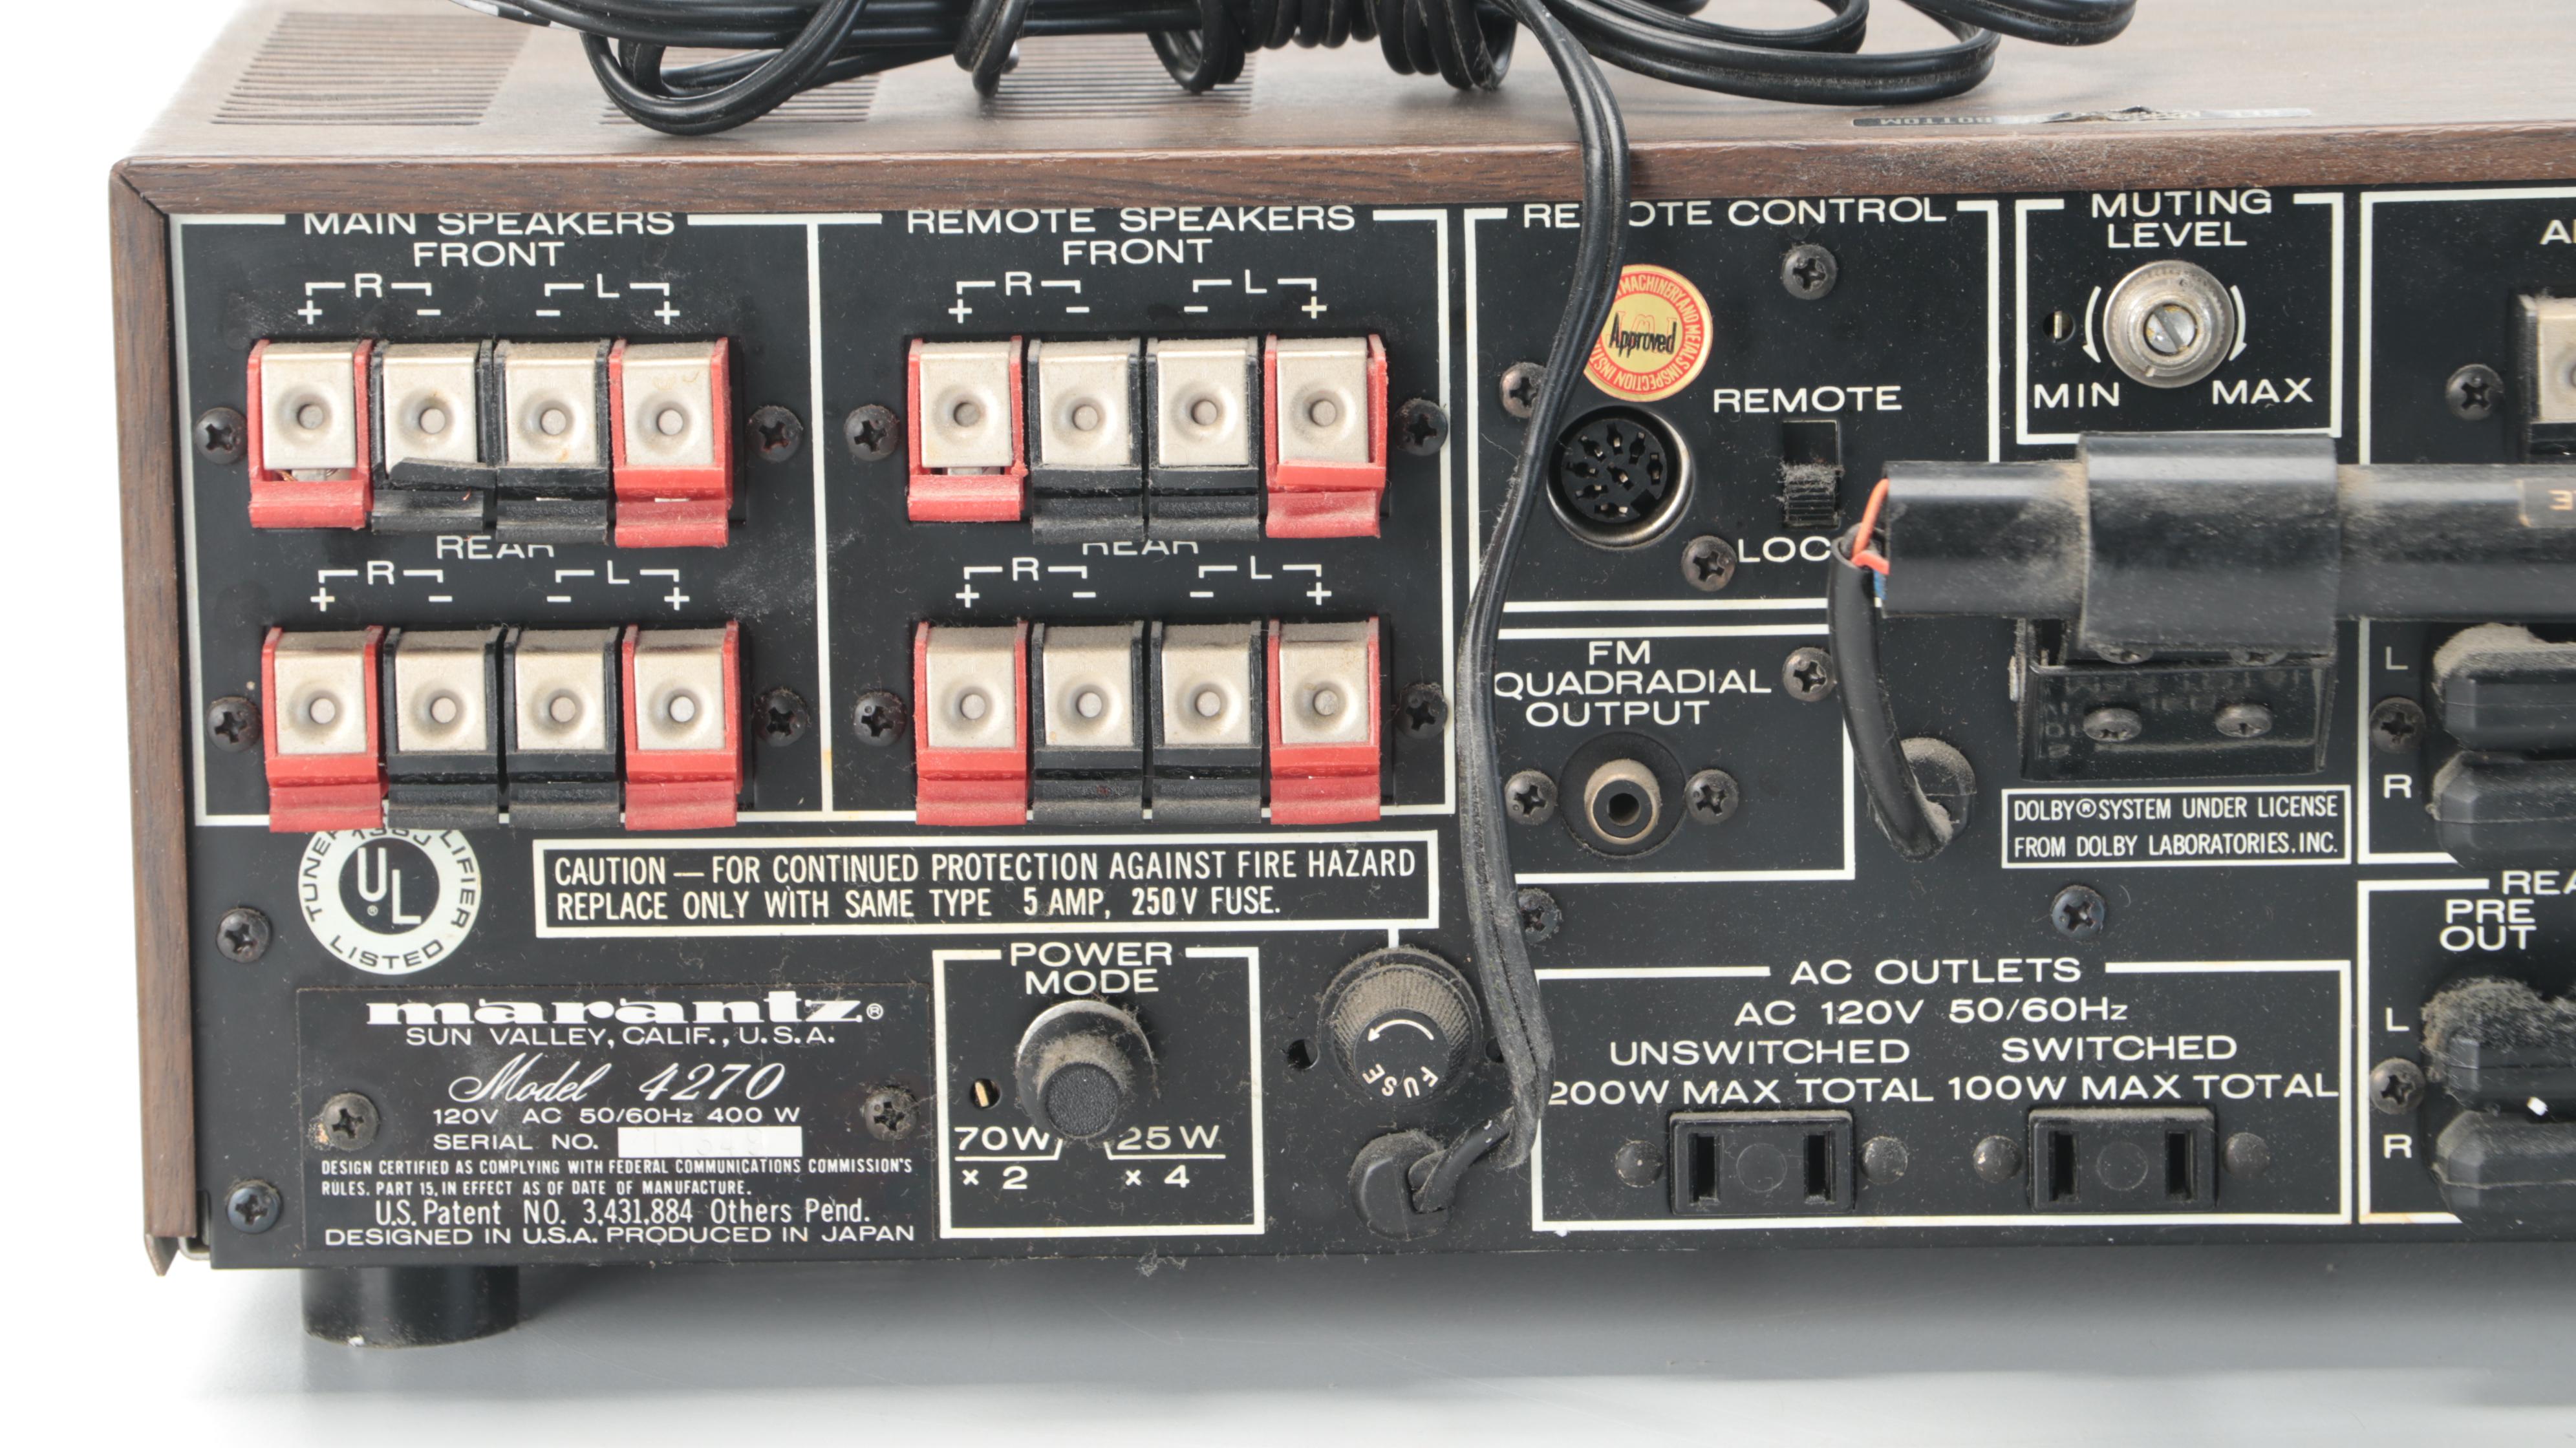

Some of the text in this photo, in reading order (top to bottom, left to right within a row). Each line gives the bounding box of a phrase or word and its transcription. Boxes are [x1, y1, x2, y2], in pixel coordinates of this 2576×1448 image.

[1880, 116, 1992, 125] BOTTOM
[1523, 197, 1947, 229] REOTE CONTROL
[2092, 188, 2272, 218] MUTING
[304, 211, 675, 235] MAIN SPEAKERS
[907, 204, 1355, 235] REMOTE SPEAKERS
[2108, 221, 2248, 248] LEVEL
[413, 240, 565, 268] FRONT
[1062, 238, 1213, 266] FRONT
[354, 273, 383, 298] R
[596, 273, 620, 299] L
[1005, 271, 1033, 296] R
[1244, 269, 1268, 294] L
[1609, 313, 1677, 358] Approved
[1713, 385, 1902, 413] REMOTE
[2034, 382, 2120, 409] MIN
[2213, 378, 2313, 405] MAX
[1738, 535, 1832, 563] LOC
[367, 560, 395, 585] R
[606, 560, 630, 584] L
[1012, 557, 1039, 582] R
[1250, 555, 1272, 580] L
[1589, 640, 1651, 665] FM
[2387, 647, 2408, 670] L
[1494, 668, 1772, 701] QUADRADIAL
[1525, 700, 1710, 727] OUTPUT
[2383, 774, 2412, 799] R
[2182, 796, 2248, 819] UNDER
[2258, 794, 2338, 818] LICENSE
[2014, 836, 2066, 858] FROM
[2076, 835, 2138, 857] DOLBY
[773, 853, 919, 884] CONTINUED
[931, 852, 1098, 882] PROTECTION
[1109, 850, 1227, 880] AGAINST
[1238, 849, 1297, 878] FIRE
[1308, 848, 1415, 878] HAZARD
[358, 847, 422, 924] UL
[557, 891, 669, 921] REPLACE
[683, 890, 749, 920] ONLY
[764, 889, 830, 919] WITH
[845, 888, 915, 919] SAME
[928, 888, 993, 917] TYPE
[1024, 886, 1038, 916] 5
[1210, 885, 1281, 915] FUSE.
[2445, 898, 2535, 924] PRE
[2440, 924, 2537, 952] OUT
[330, 935, 444, 969] LISTED
[1010, 941, 1173, 968] POWER
[1025, 968, 1159, 996] MODE
[1790, 957, 2082, 985] AC OUTLETS
[1734, 996, 2128, 1027] AC 120V 50/60Hz
[2385, 1007, 2410, 1032] L
[405, 1027, 472, 1047] SUN
[489, 1027, 615, 1049] VALLEY,
[739, 1025, 835, 1045] U.S.A.
[2001, 1034, 2237, 1063] SWITCHED
[1610, 1038, 1910, 1067] UNSWITCHED
[448, 1052, 786, 1104] Model 4270
[1362, 1063, 1439, 1098] FUSE
[1547, 1077, 1935, 1105] 200W MAX TOTAL
[1948, 1070, 2340, 1101] 100W MAX TOTAL
[433, 1107, 500, 1125] 120V
[521, 1107, 562, 1125] AC
[579, 1107, 694, 1124] 50/60Hz
[433, 1133, 599, 1151] SERIAL NO.
[954, 1125, 1050, 1151] 70W
[2383, 1134, 2412, 1159] R
[321, 1158, 912, 1176] DESIGN CERTIFIED AS COMPLYING WITH FEDERAL COMMUNICATIONS COMMISSION'S
[1002, 1165, 1028, 1190] 2
[1164, 1164, 1190, 1188] 4
[376, 1180, 413, 1196] PART
[442, 1180, 457, 1196] IN
[462, 1180, 513, 1196] EFFECT
[522, 1180, 541, 1196] AS
[546, 1180, 564, 1196] OF
[572, 1179, 606, 1195] DATE
[616, 1180, 633, 1196] OF
[641, 1179, 752, 1195] MANUFACTURE.
[375, 1196, 870, 1227] U.S. Patent NO. 3,431,884 Others Pend.
[325, 1225, 914, 1246] DESIGNED IN U.S.A. PRODUCED IN JAPAN
